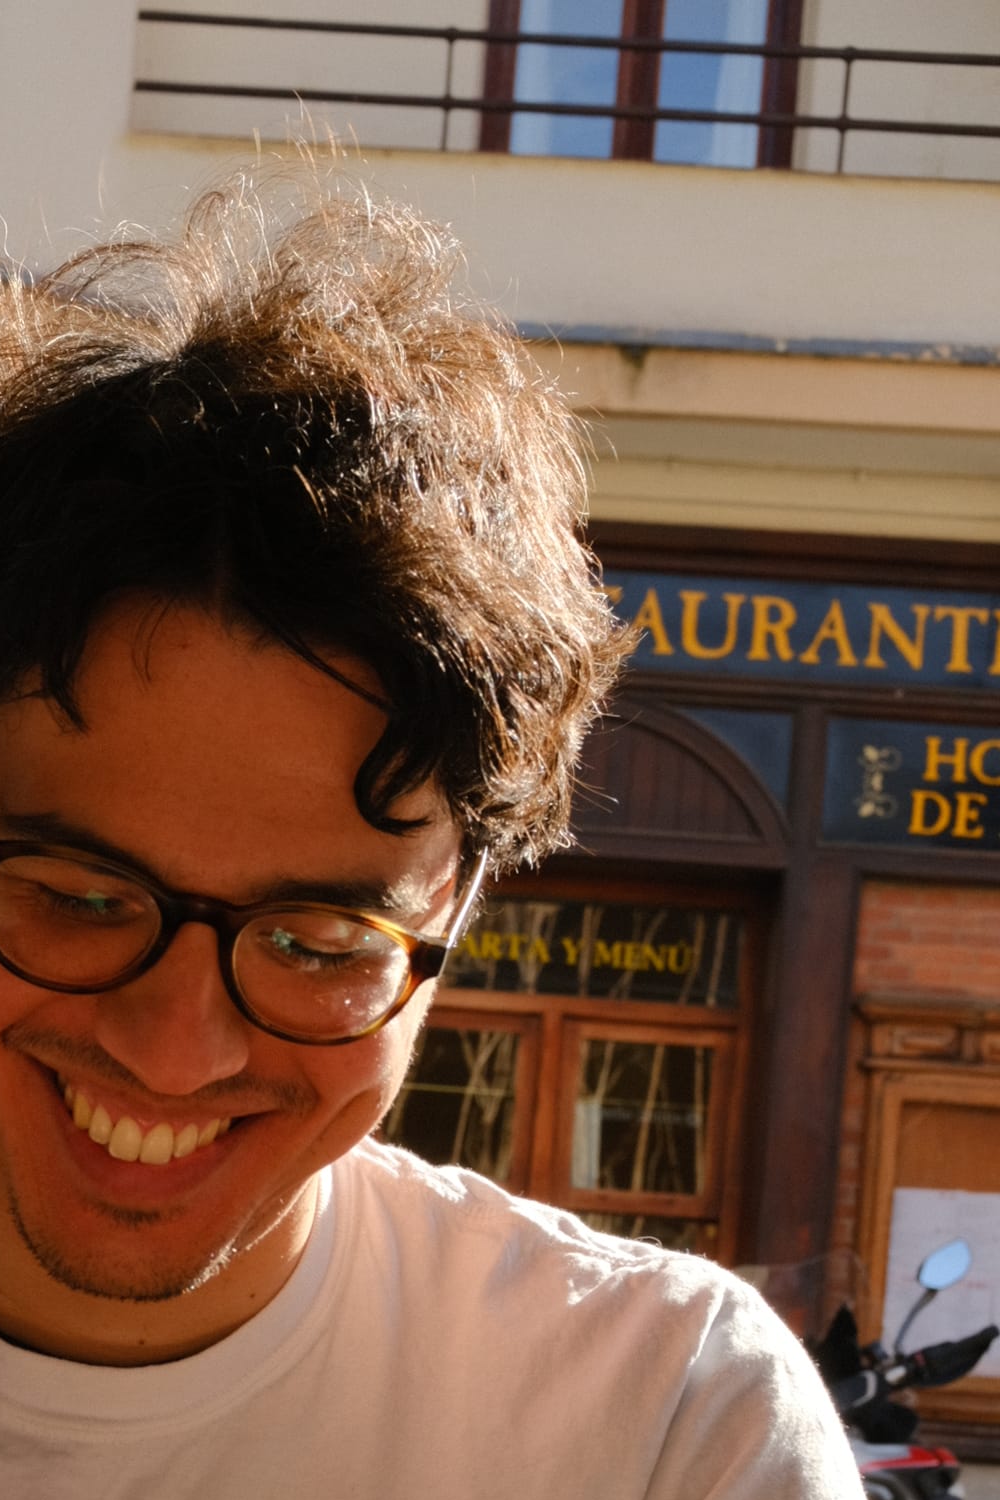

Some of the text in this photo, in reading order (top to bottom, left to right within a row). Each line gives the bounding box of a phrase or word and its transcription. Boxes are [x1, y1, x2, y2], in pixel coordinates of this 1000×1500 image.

[606, 584, 1000, 676] AURANT
[908, 789, 988, 839] DE
[458, 930, 551, 964] ARTA
[561, 936, 583, 966] Y
